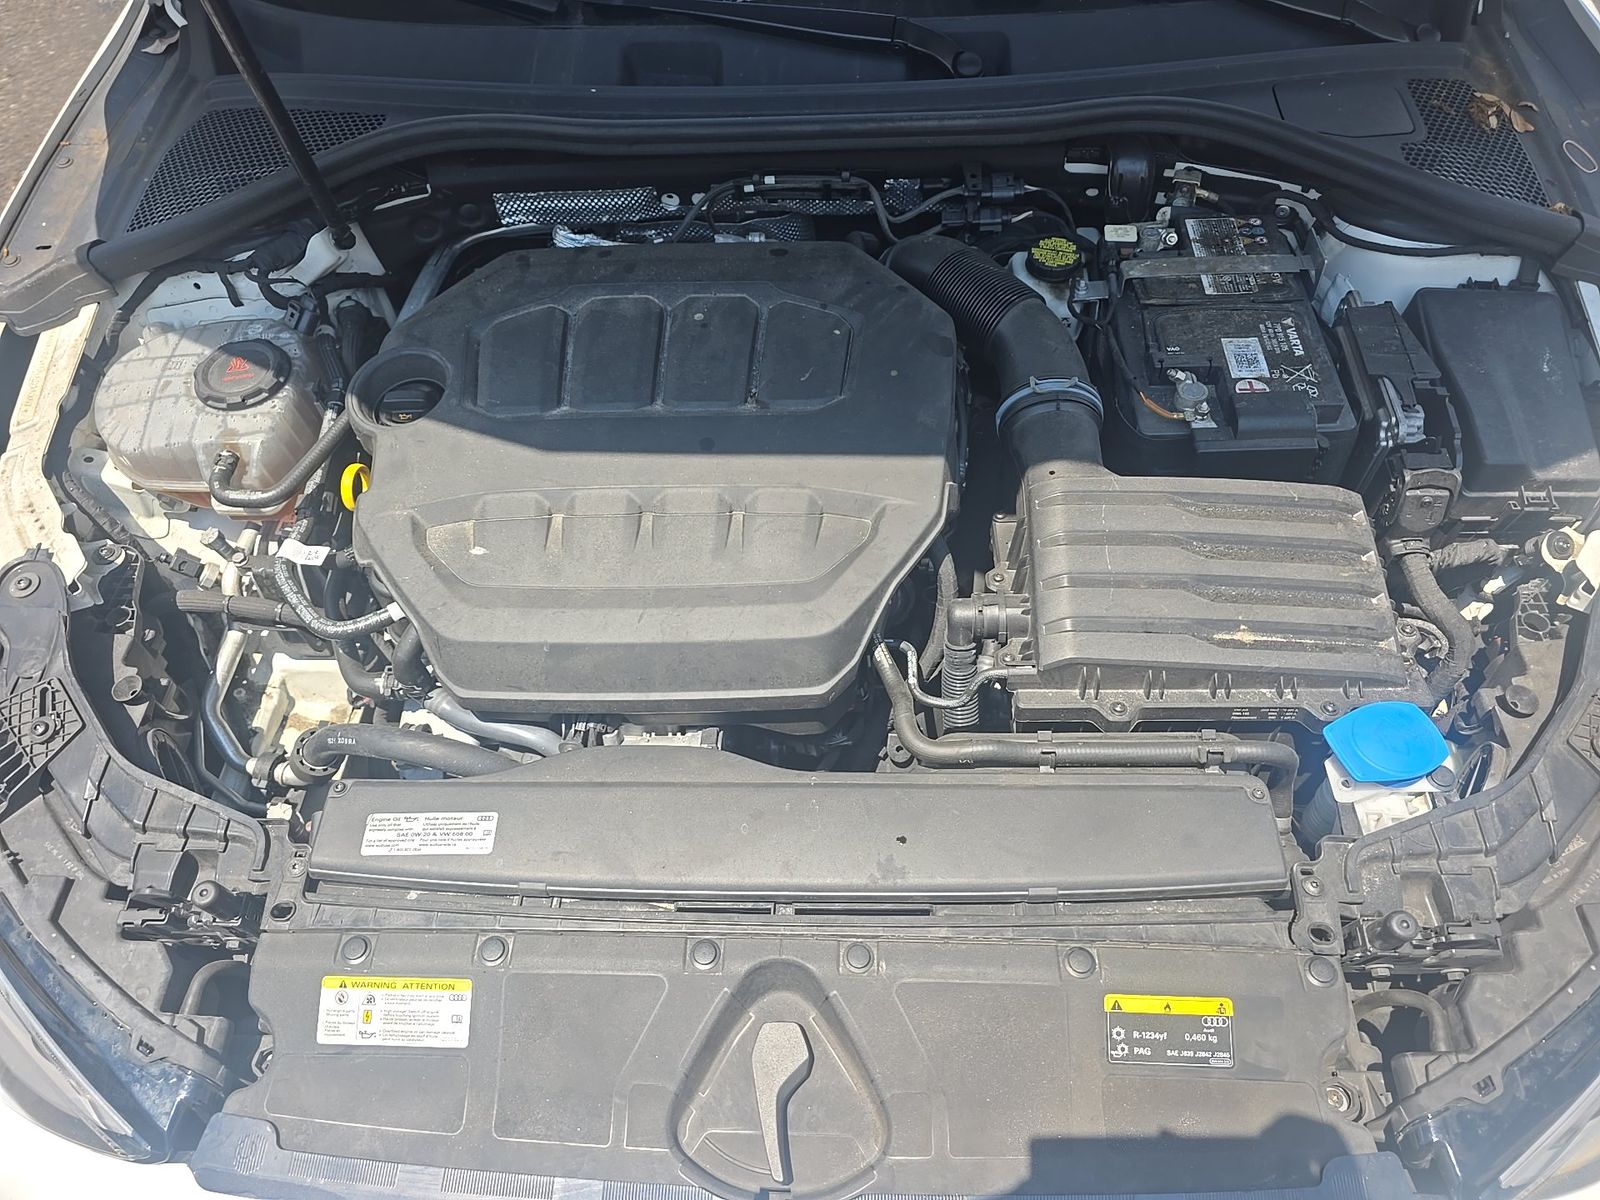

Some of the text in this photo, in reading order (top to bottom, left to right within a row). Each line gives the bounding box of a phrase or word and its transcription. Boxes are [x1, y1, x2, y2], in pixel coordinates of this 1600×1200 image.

[1286, 327, 1305, 357] VARTA
[351, 981, 456, 991] WARNING ATTENTION
[1132, 1031, 1218, 1043] R-1234yf 0,460 kg
[1133, 1047, 1152, 1056] PAG
